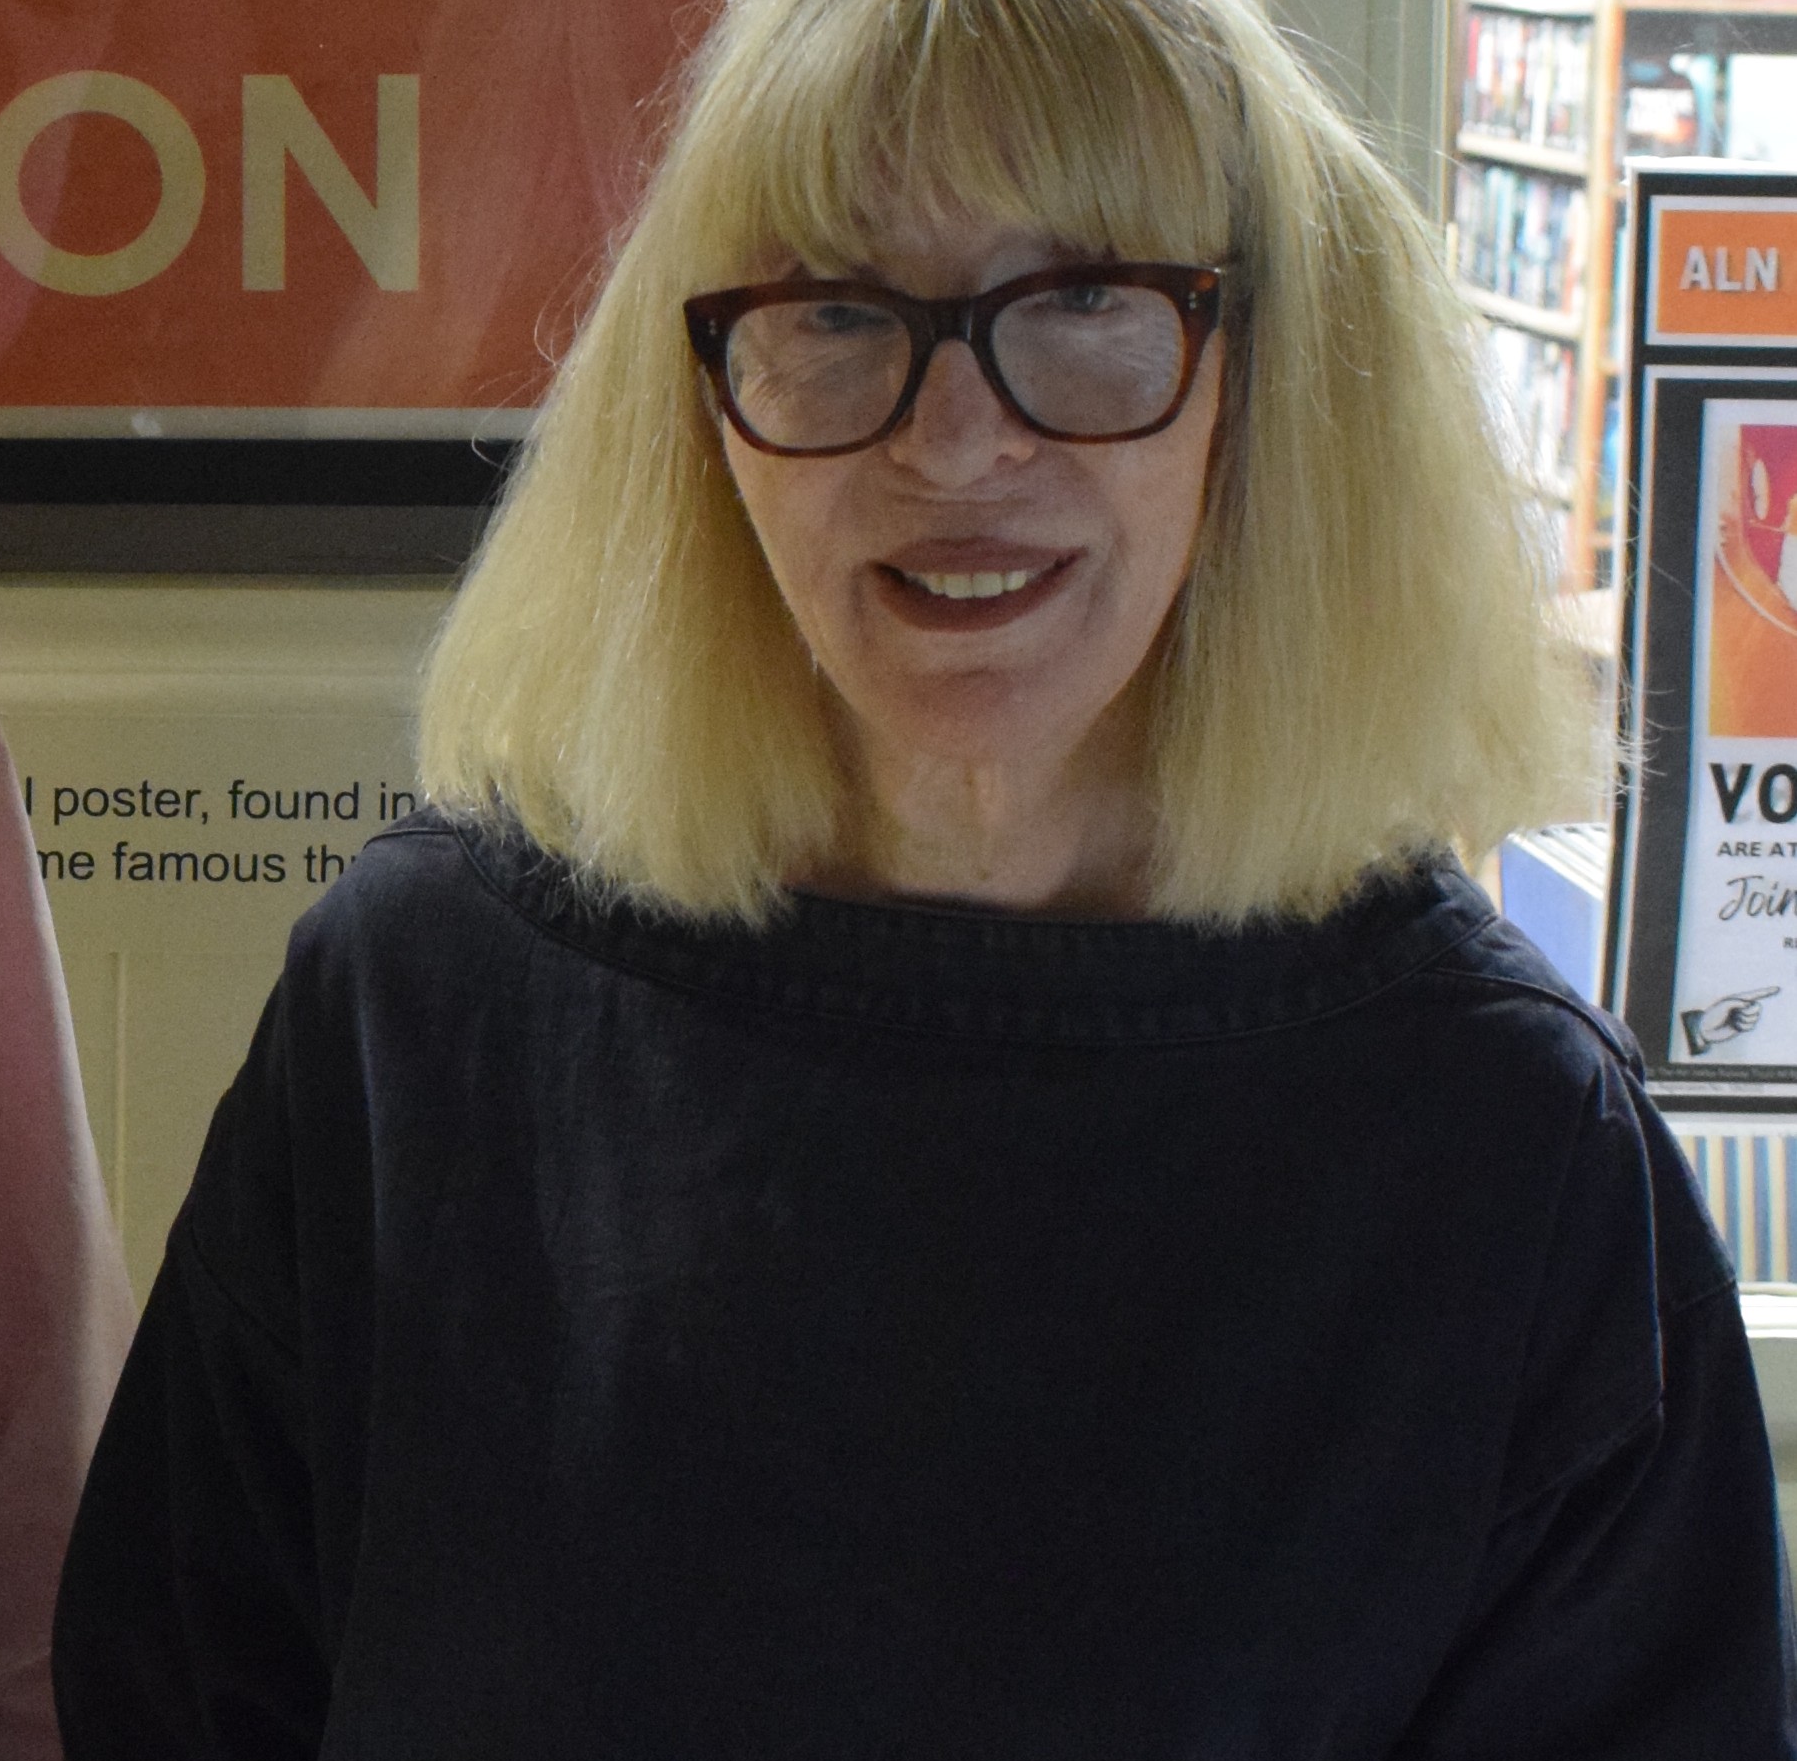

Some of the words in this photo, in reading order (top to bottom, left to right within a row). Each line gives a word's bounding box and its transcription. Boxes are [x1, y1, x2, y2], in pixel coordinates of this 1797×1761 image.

[1680, 244, 1779, 292] ALN
[53, 779, 209, 826] poster,
[228, 779, 360, 820] found
[1710, 761, 1797, 825] VO
[112, 841, 286, 883] famous
[303, 844, 356, 883] th
[1717, 840, 1762, 858] ARE
